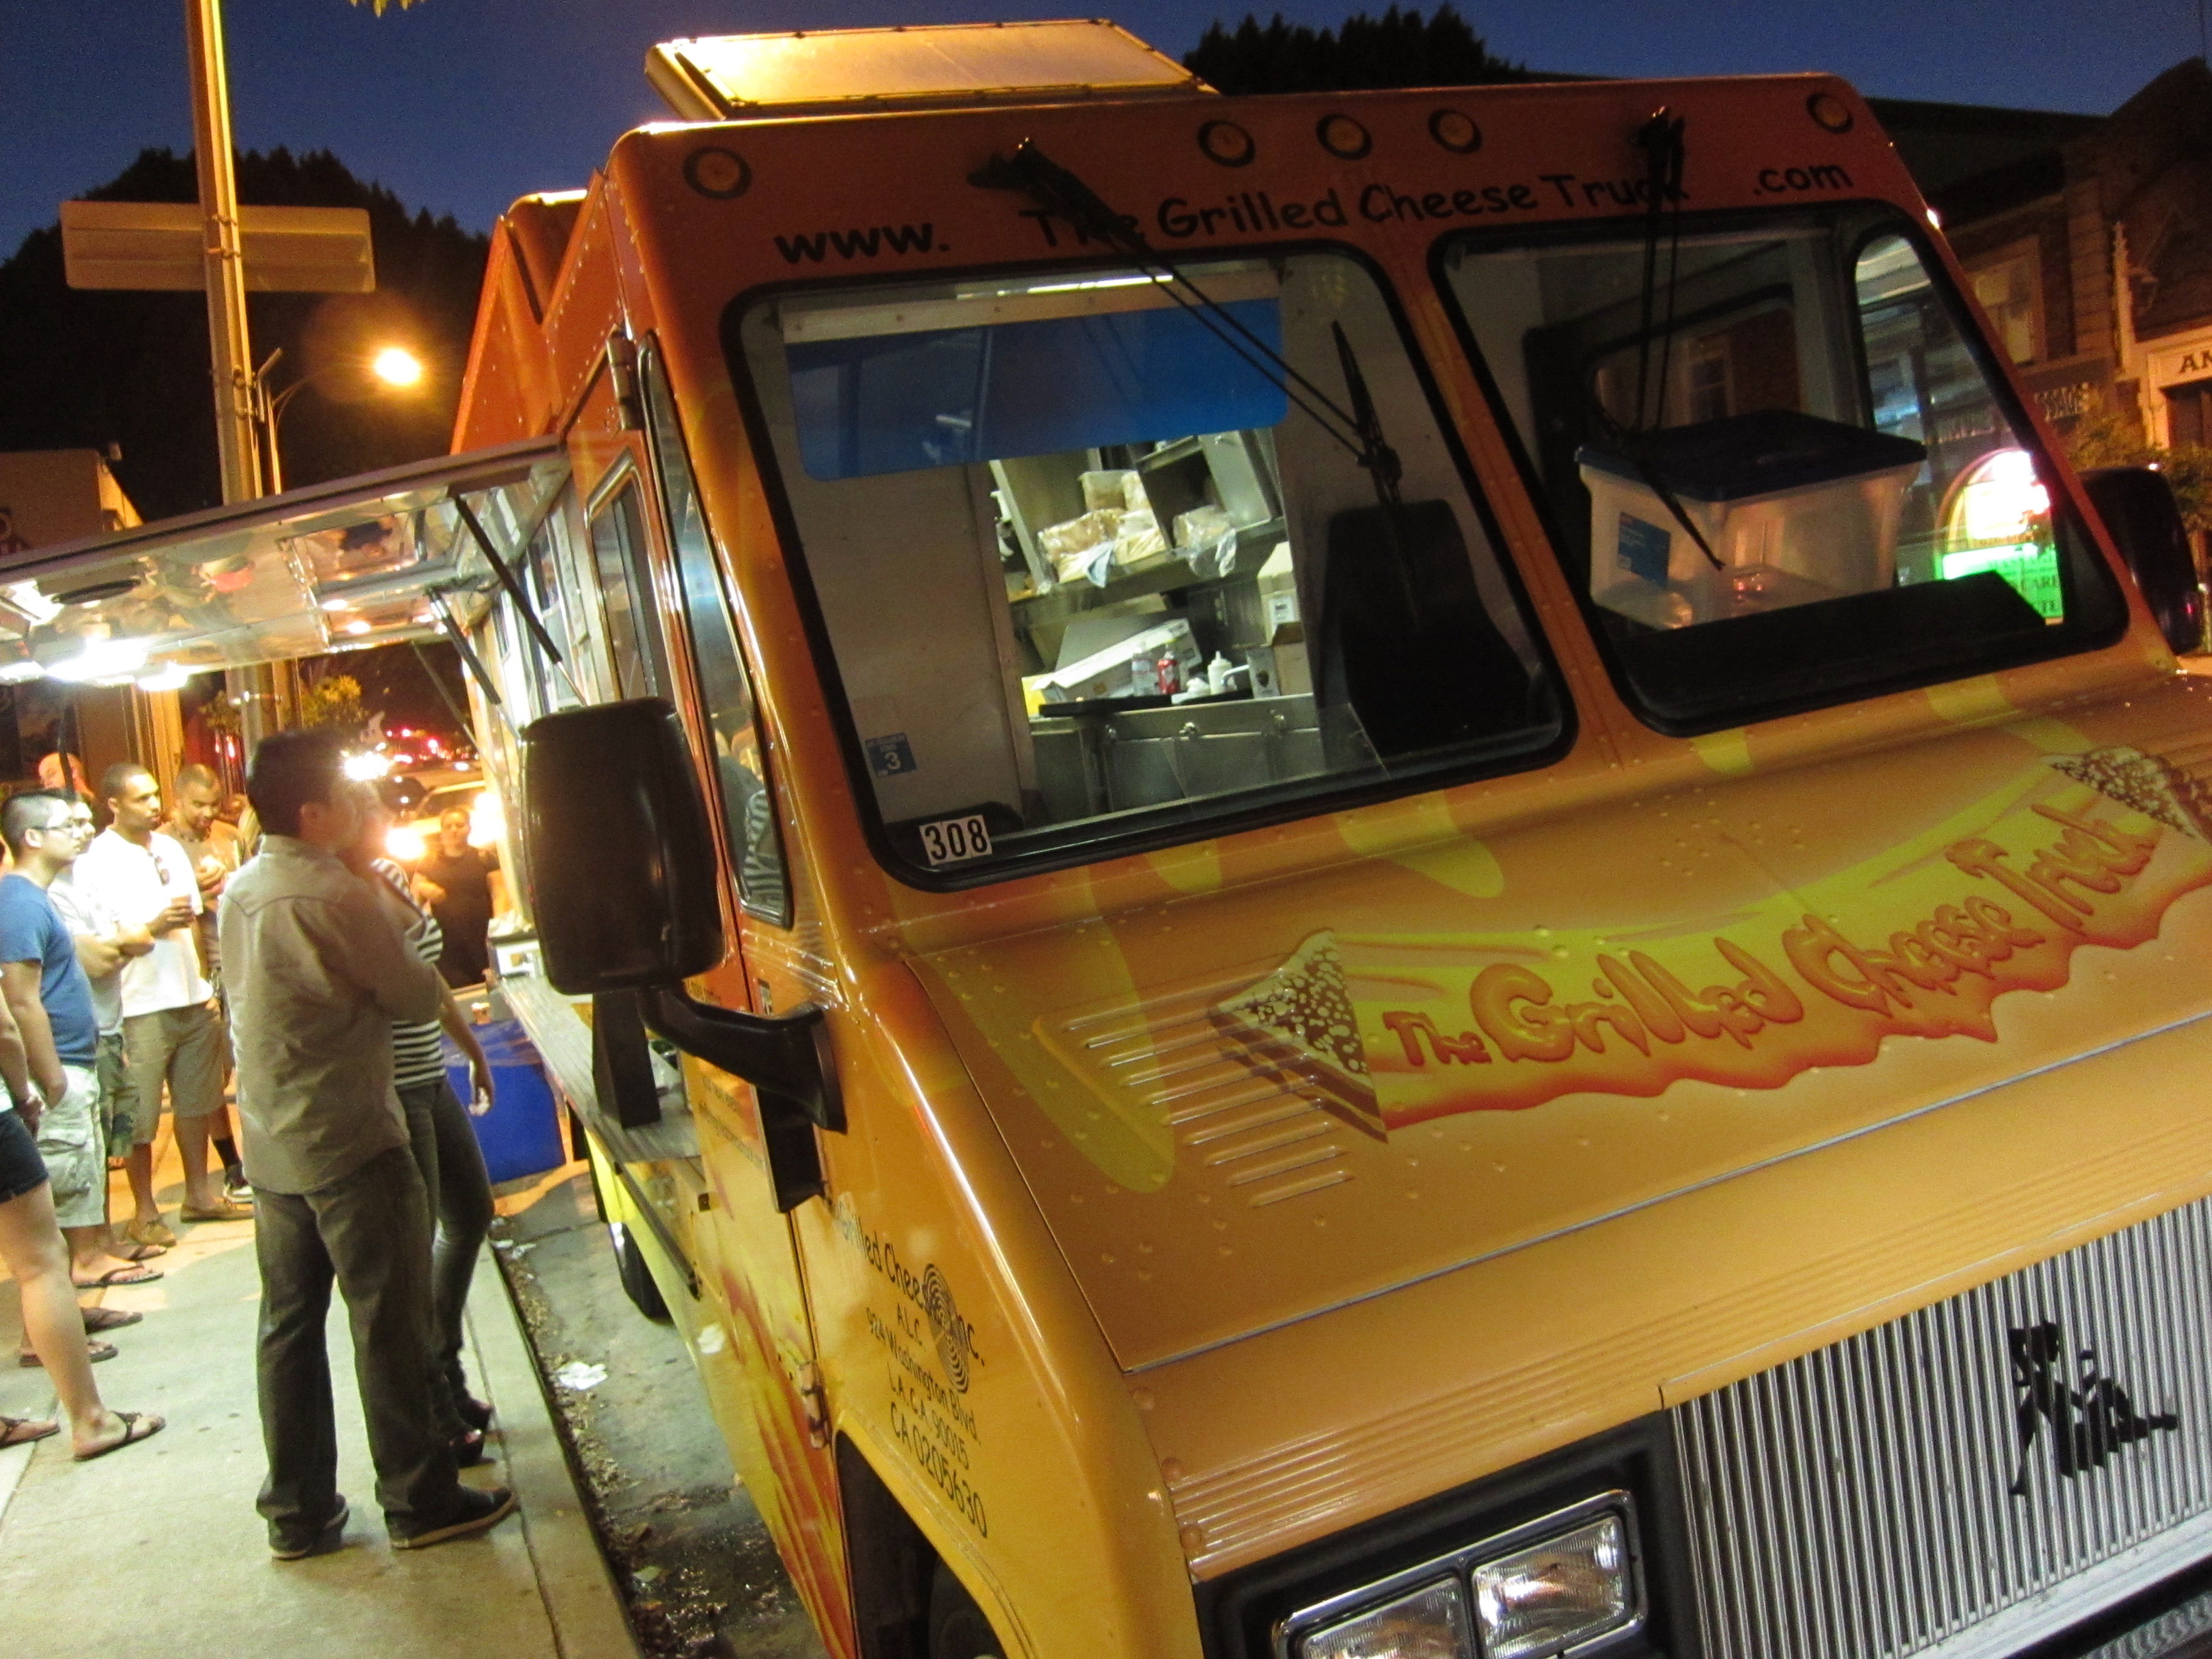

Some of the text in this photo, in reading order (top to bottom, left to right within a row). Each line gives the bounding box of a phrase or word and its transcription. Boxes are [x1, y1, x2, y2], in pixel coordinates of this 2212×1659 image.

[773, 221, 950, 264] www.
[1158, 189, 1349, 240] Grilled
[1359, 181, 1538, 223] Cheese
[1752, 164, 1854, 196] .com
[884, 752, 902, 770] 3
[924, 819, 988, 860] 308
[1382, 804, 2163, 1066] The Grilled Cheese Truck
[885, 1243, 934, 1318] Chee
[885, 1327, 950, 1413] Washington
[891, 1401, 987, 1538] CA 0205630
[931, 1410, 970, 1470] 90015
